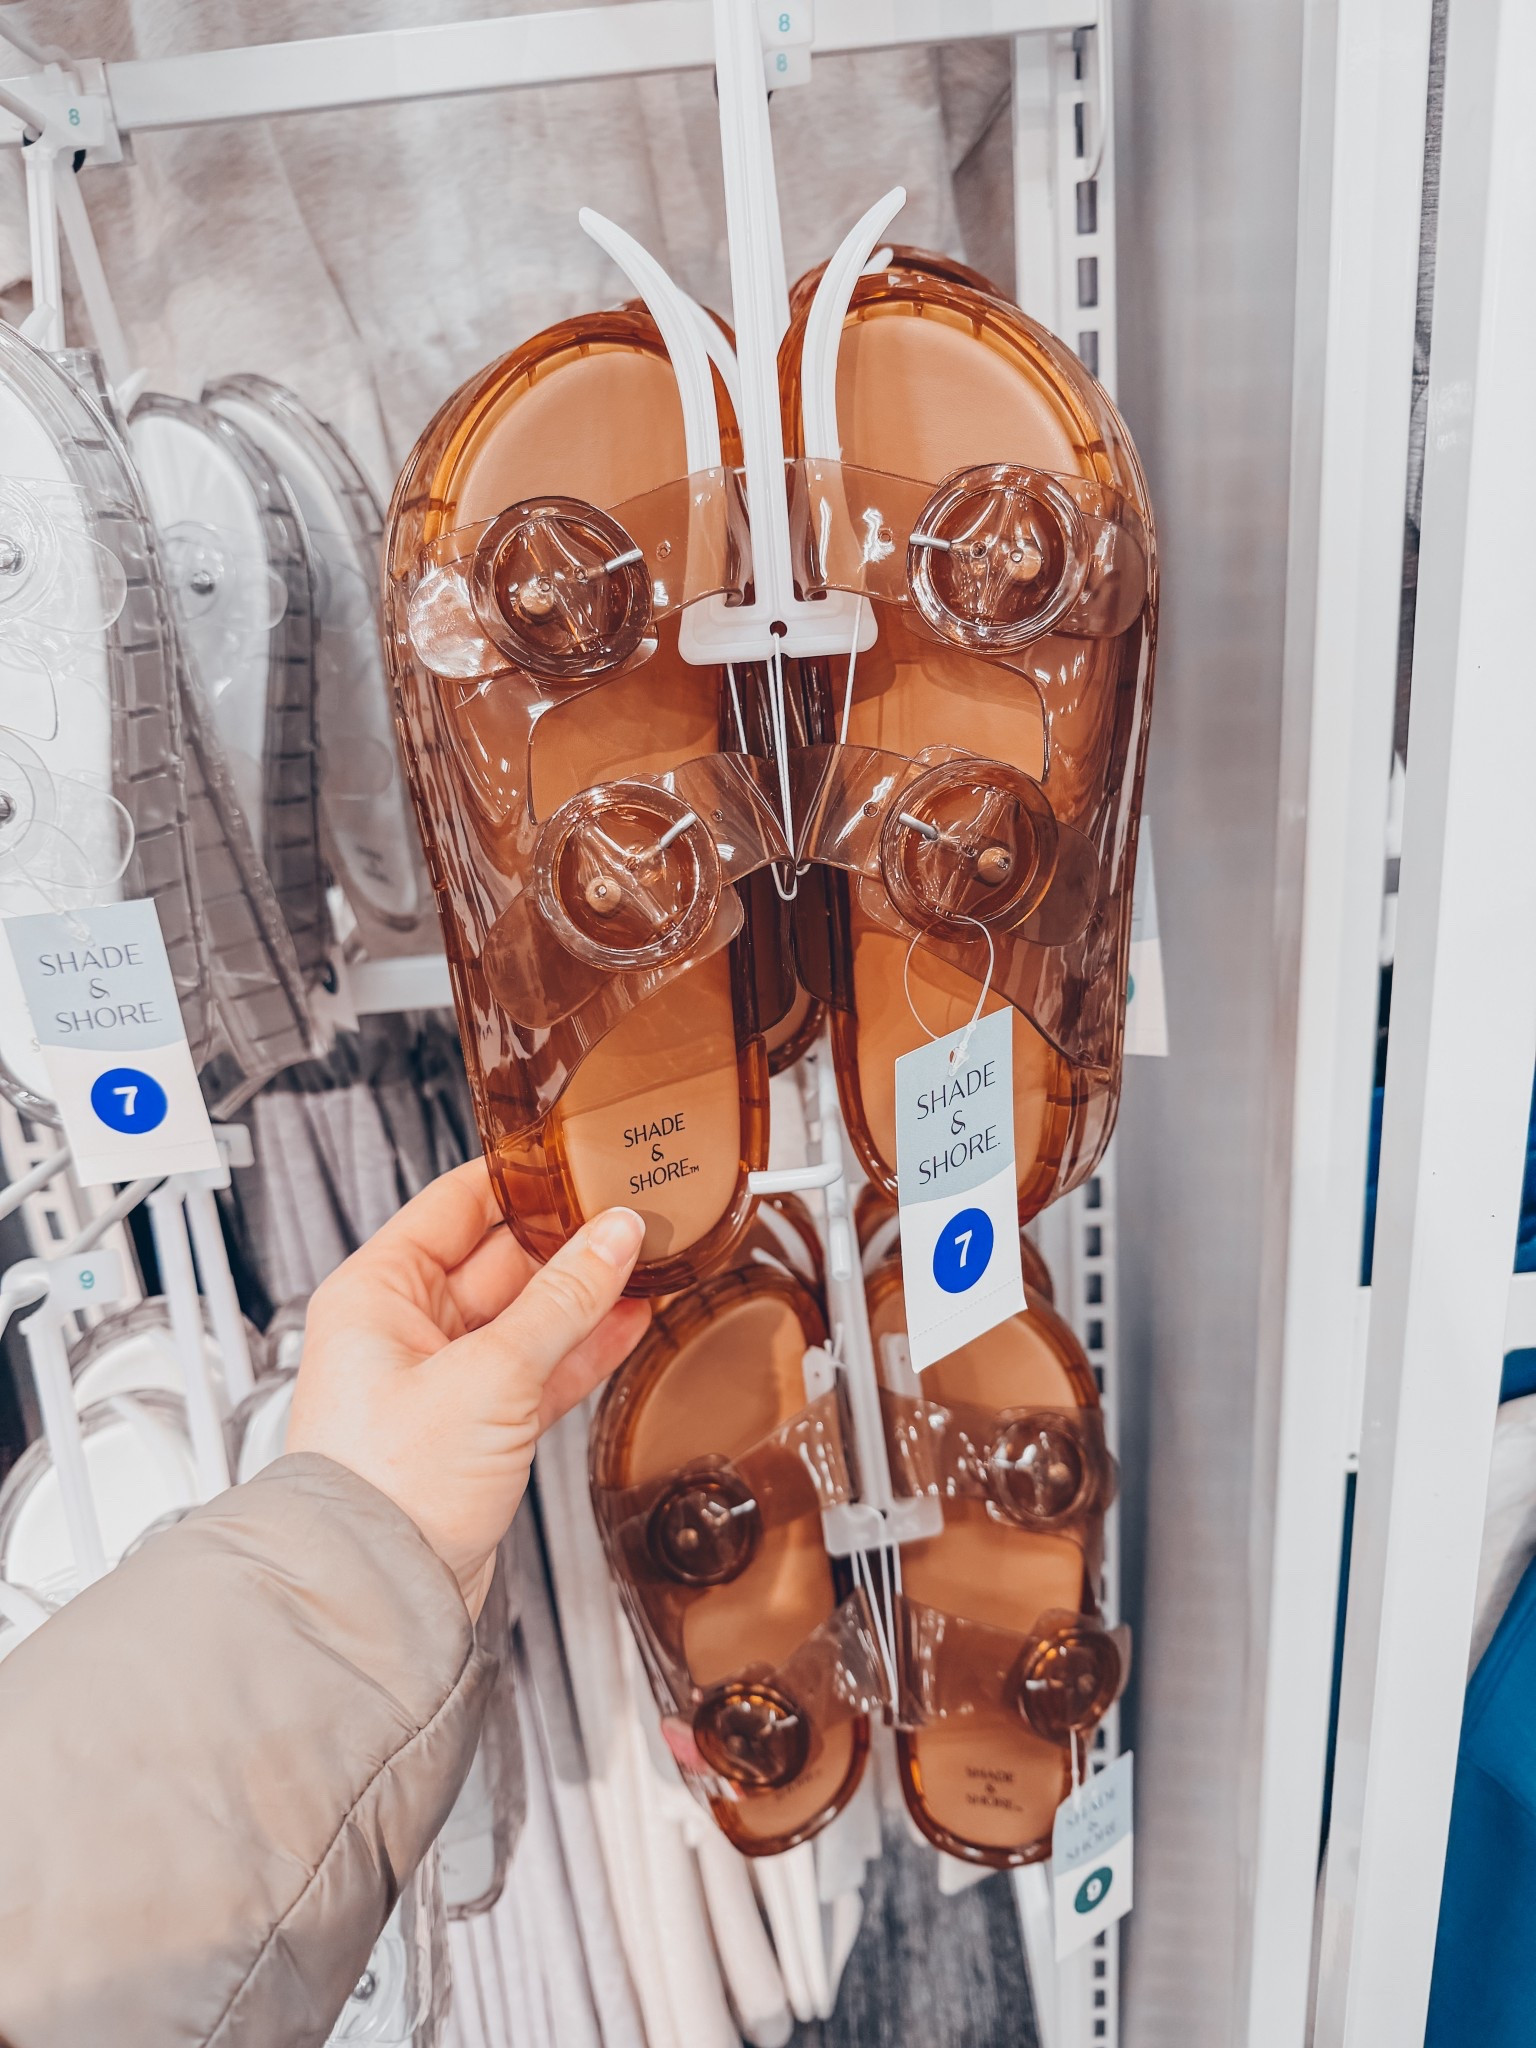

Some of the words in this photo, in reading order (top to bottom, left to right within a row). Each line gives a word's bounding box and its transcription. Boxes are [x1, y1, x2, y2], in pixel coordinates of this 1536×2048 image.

[778, 13, 790, 32] 8
[776, 53, 788, 72] 8
[68, 108, 80, 126] 8
[38, 943, 144, 977] SHADE
[89, 978, 110, 999] &
[55, 1001, 160, 1033] SHORE
[112, 1086, 139, 1116] 7
[916, 1060, 996, 1120] SHADE
[623, 1112, 686, 1148] SHADE
[950, 1110, 966, 1136] &
[651, 1143, 665, 1162] &
[954, 1229, 973, 1268] 7
[80, 1270, 95, 1290] 9
